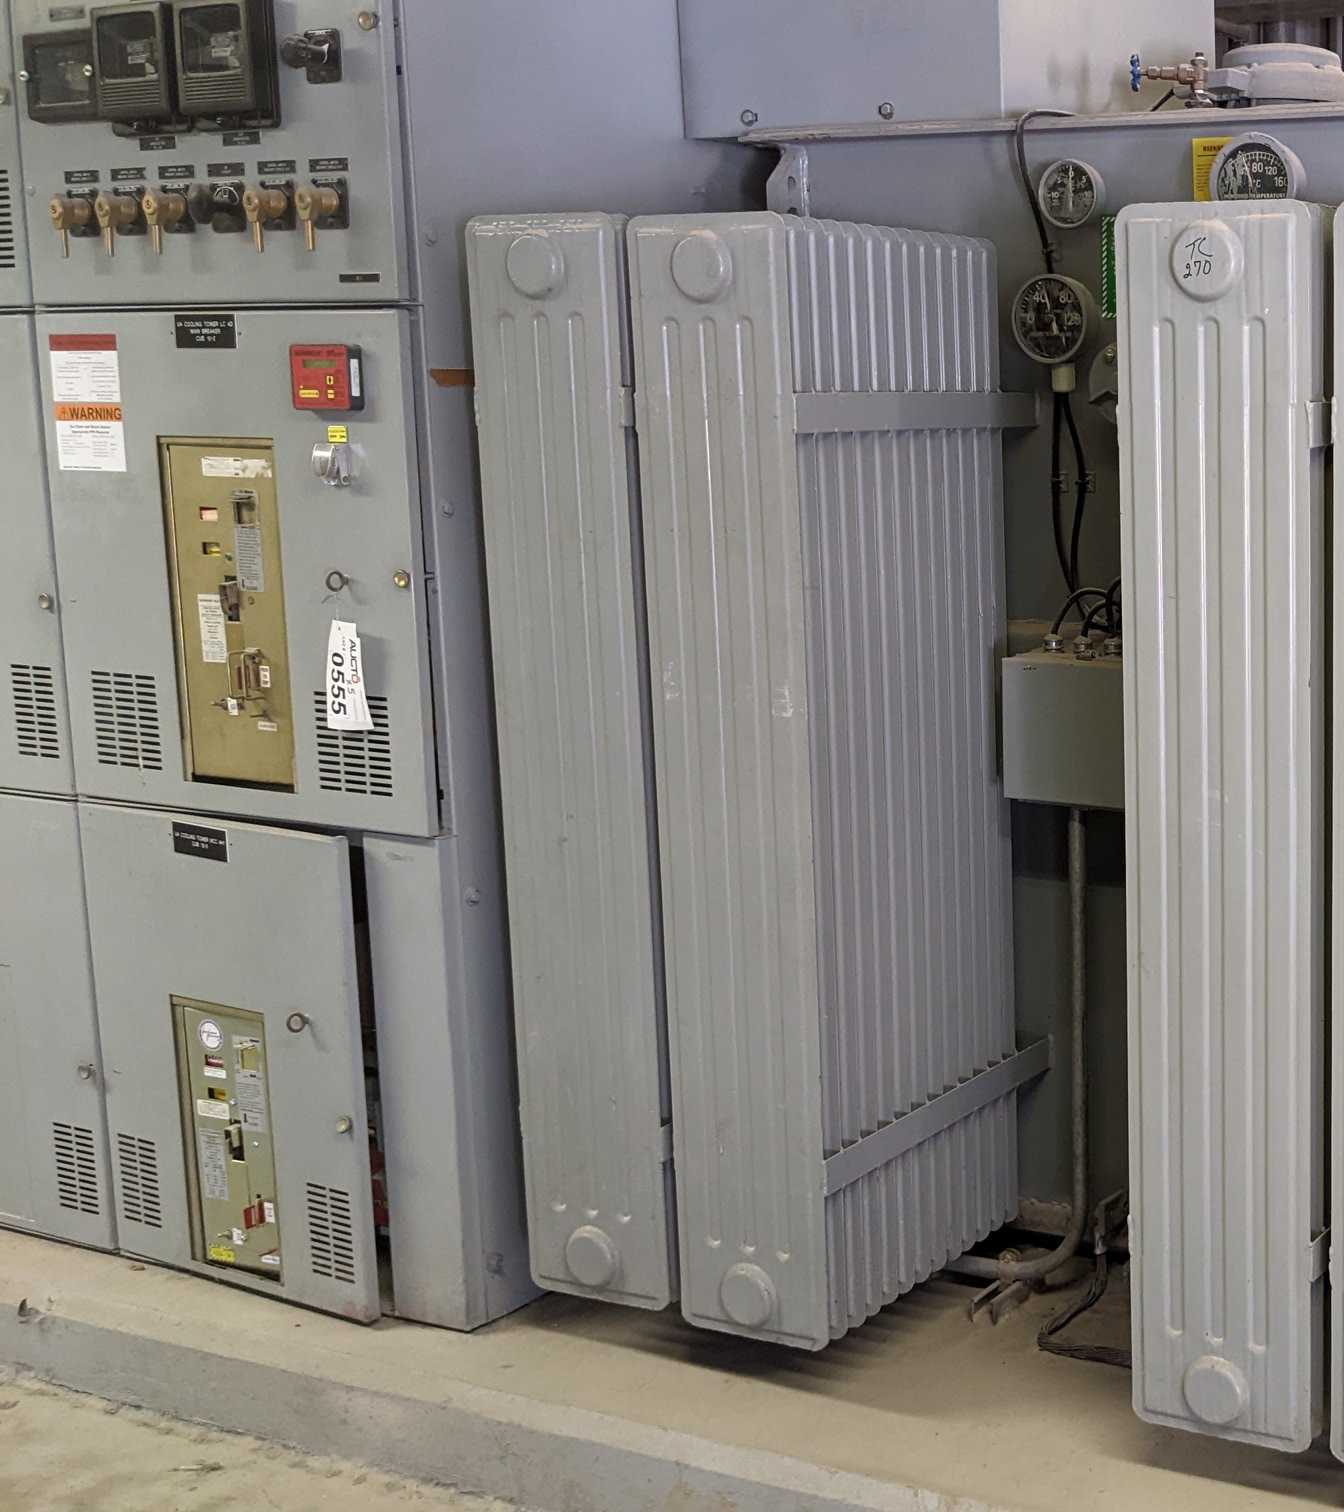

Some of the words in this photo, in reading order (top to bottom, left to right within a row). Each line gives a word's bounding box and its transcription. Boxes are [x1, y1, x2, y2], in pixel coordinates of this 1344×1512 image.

[1251, 162, 1263, 172] 80
[1265, 166, 1277, 175] 120
[1185, 237, 1213, 260] TC
[1183, 260, 1212, 278] 270
[69, 407, 122, 420] WARNING
[331, 652, 347, 715] 0555
